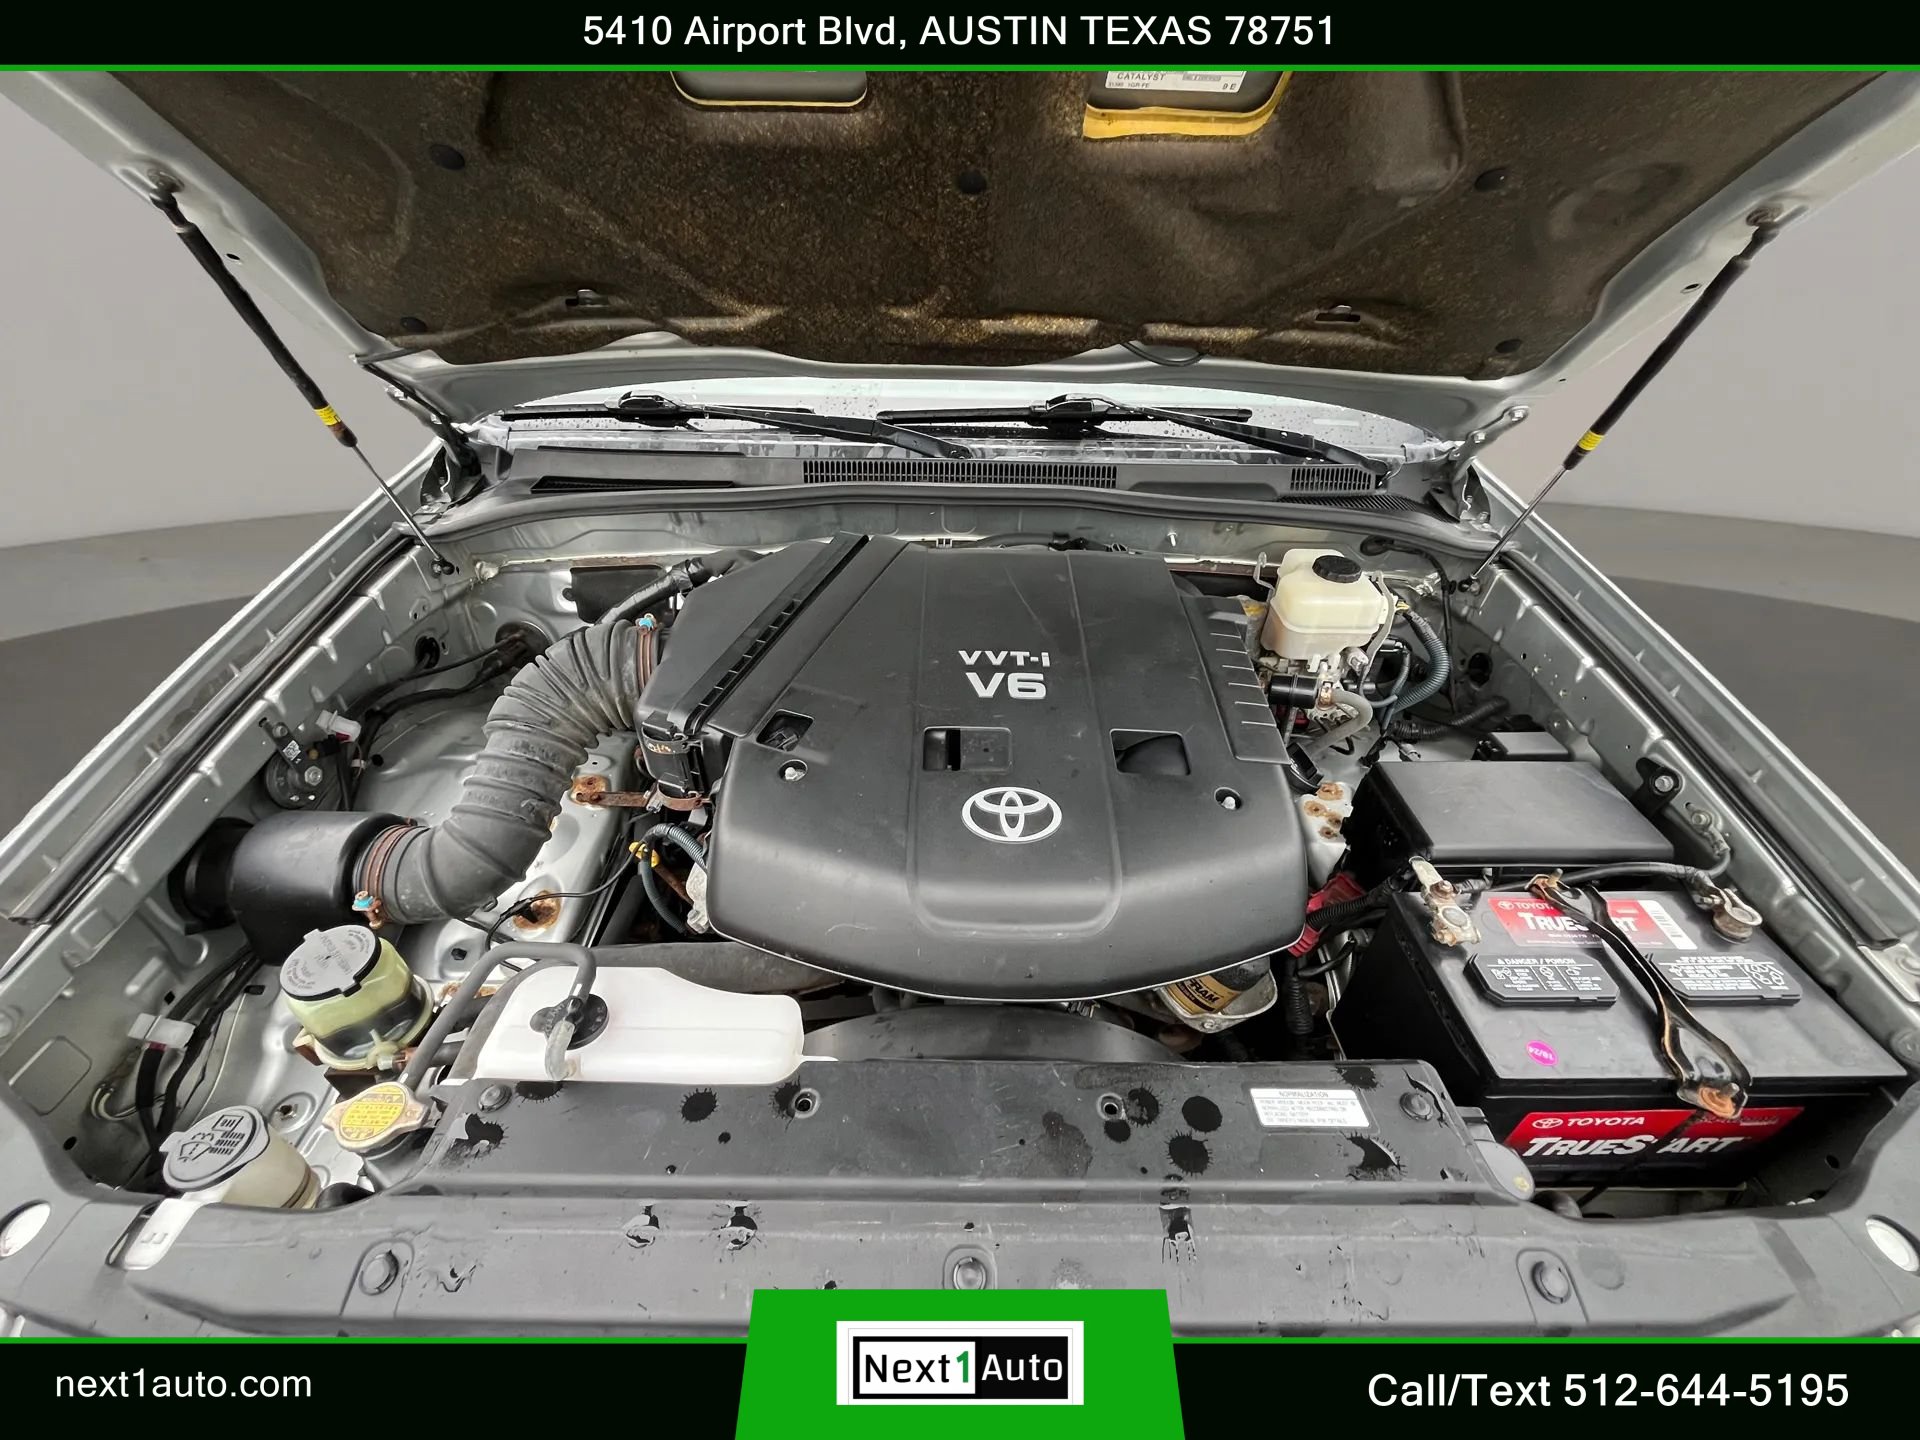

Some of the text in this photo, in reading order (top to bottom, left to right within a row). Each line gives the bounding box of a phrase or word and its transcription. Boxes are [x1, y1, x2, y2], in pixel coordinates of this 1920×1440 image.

[1117, 72, 1166, 80] CATALYST
[965, 672, 1046, 699] V6
[1515, 902, 1553, 911] TOYOT
[1567, 1116, 1645, 1127] TOYOTA
[1522, 1134, 1744, 1157] TRUESART
